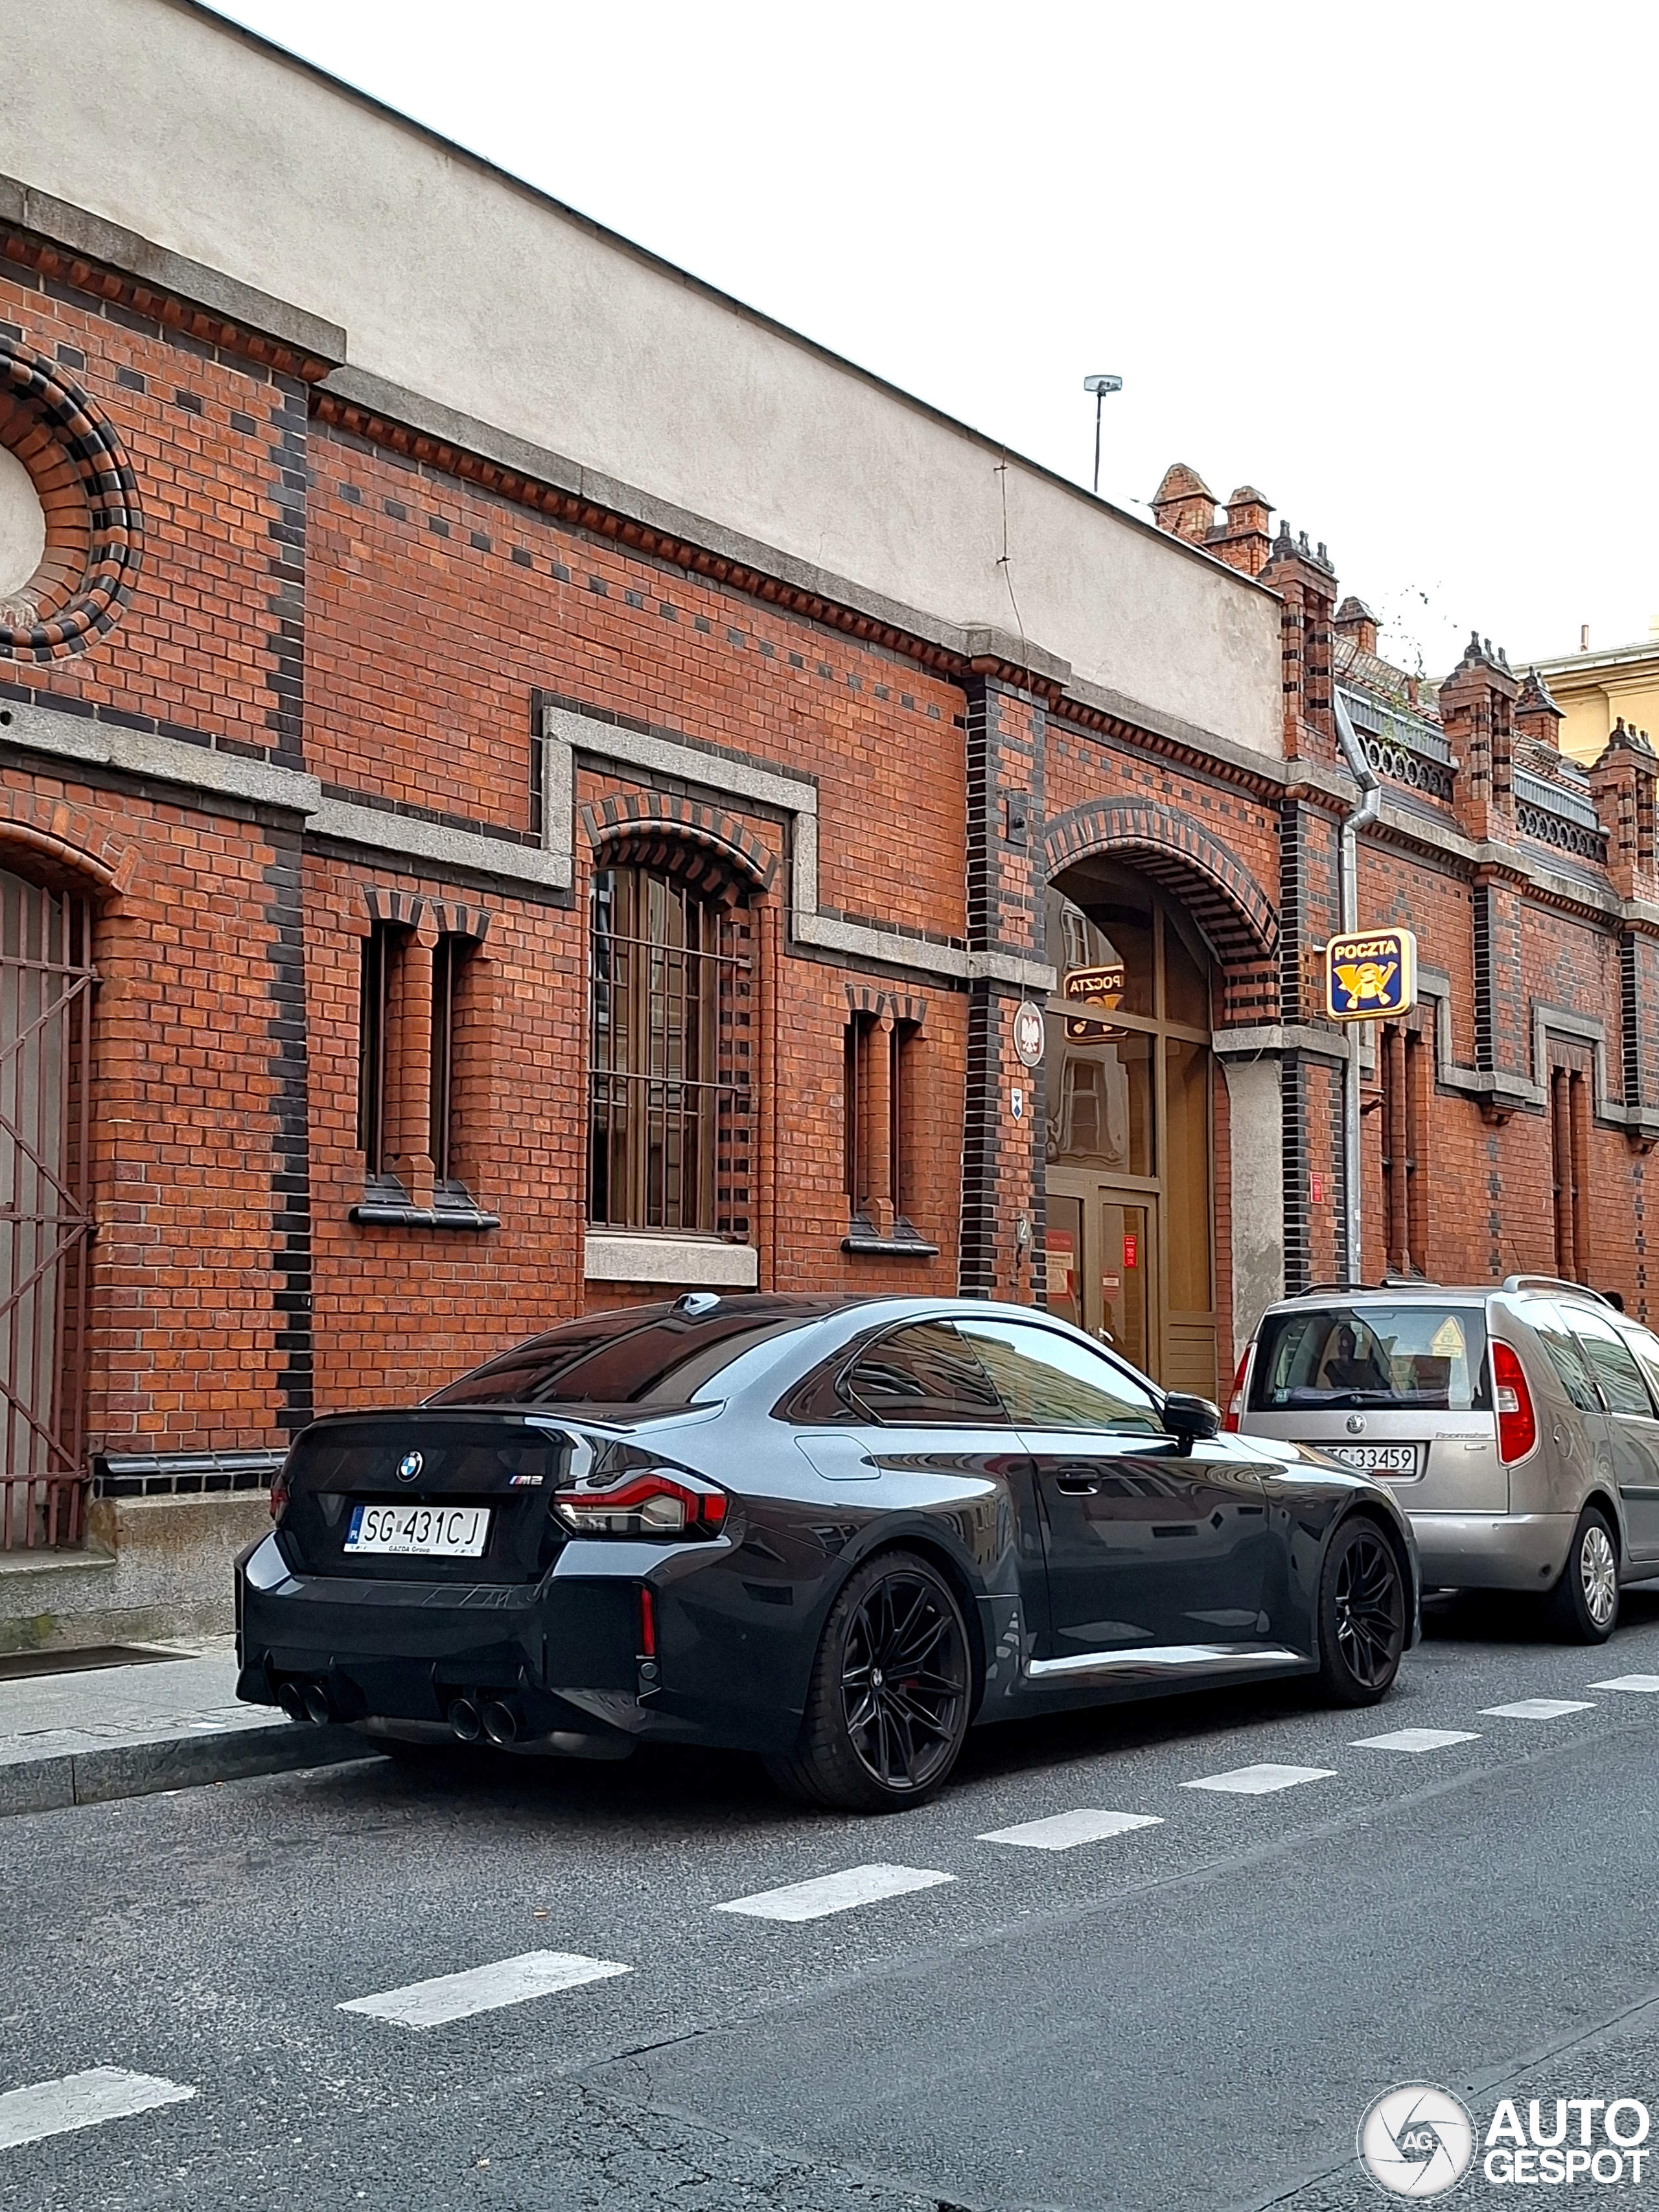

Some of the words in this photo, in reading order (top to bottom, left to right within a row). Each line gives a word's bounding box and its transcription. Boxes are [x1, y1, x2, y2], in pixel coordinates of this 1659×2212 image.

[1335, 940, 1398, 961] POCZTA
[1019, 1218, 1027, 1239] 2
[1435, 1431, 1492, 1439] Roomster
[1355, 1449, 1412, 1468] 33459
[514, 1475, 544, 1485] M2
[364, 1510, 396, 1543] SG
[402, 1510, 480, 1545] 431CJ
